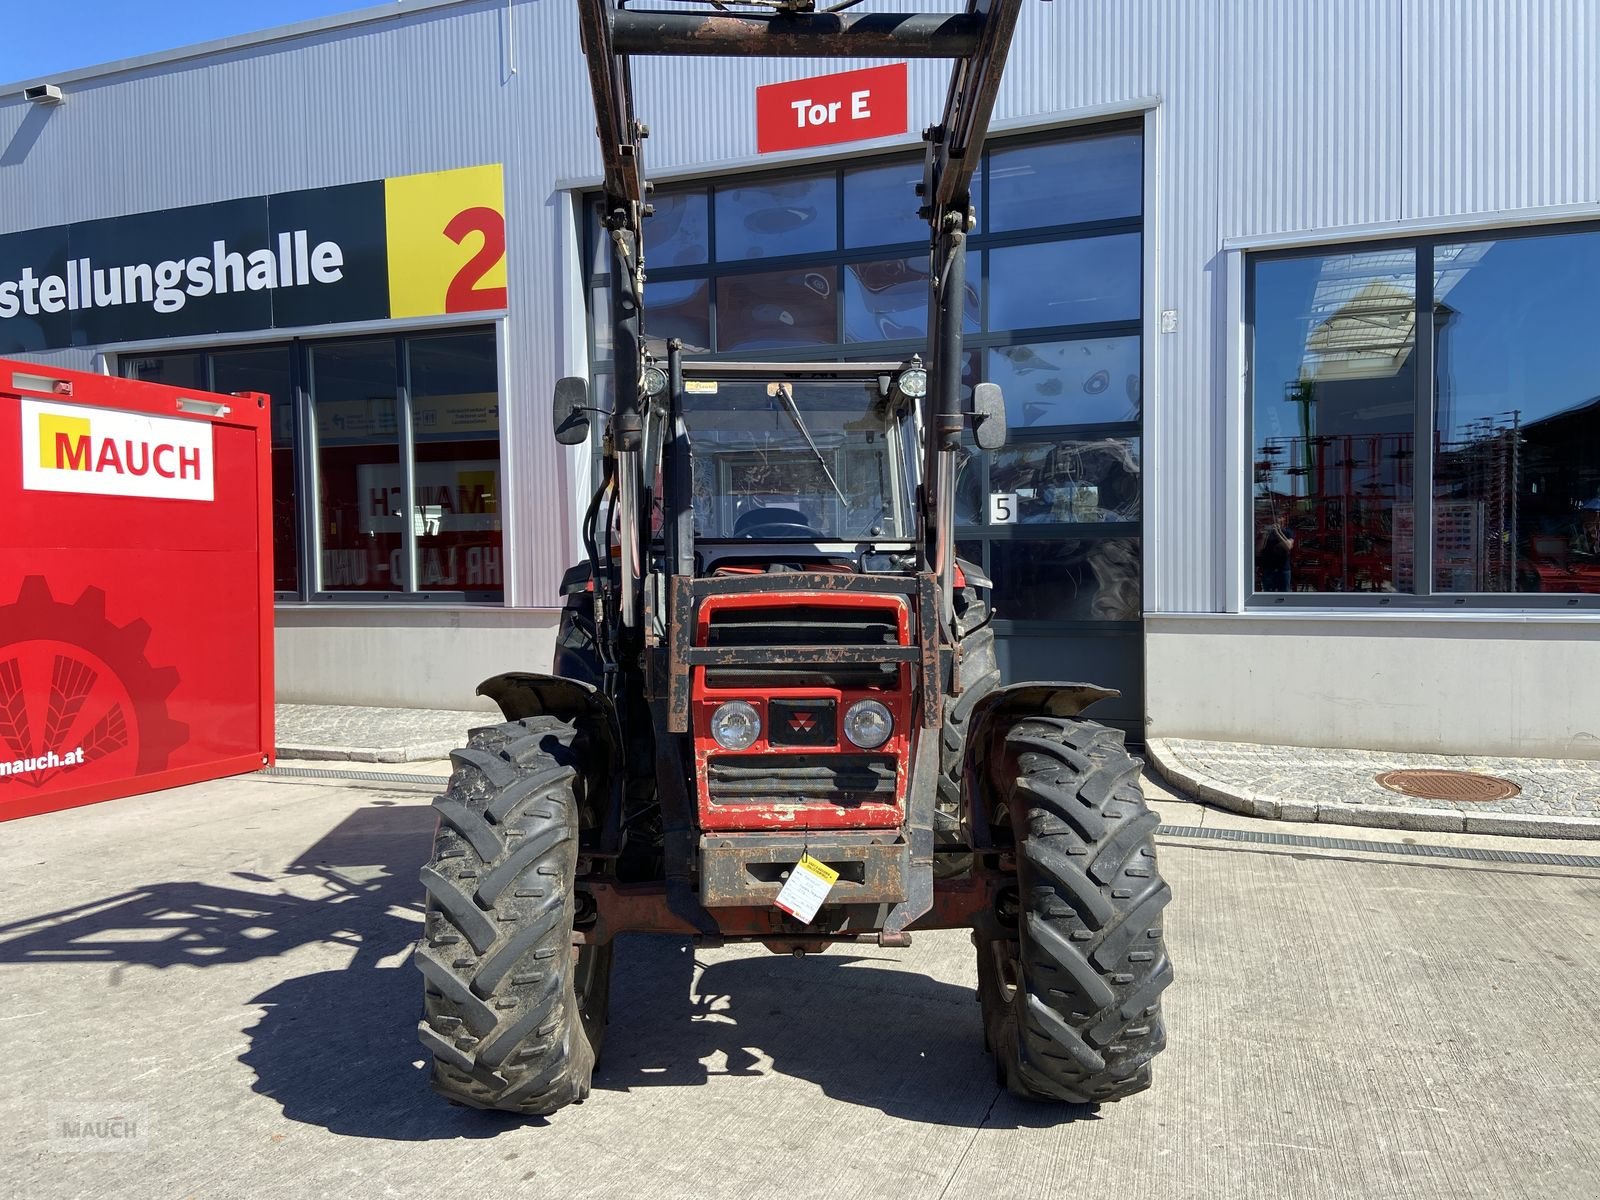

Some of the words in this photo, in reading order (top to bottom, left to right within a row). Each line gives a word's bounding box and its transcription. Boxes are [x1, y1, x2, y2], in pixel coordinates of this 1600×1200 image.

[791, 99, 842, 128] Tor
[851, 89, 871, 120] E
[0, 230, 344, 318] stellungshalle
[442, 206, 507, 314] 2
[55, 432, 201, 480] MAUCH
[996, 498, 1011, 521] 5
[0, 747, 84, 776] mauch.at
